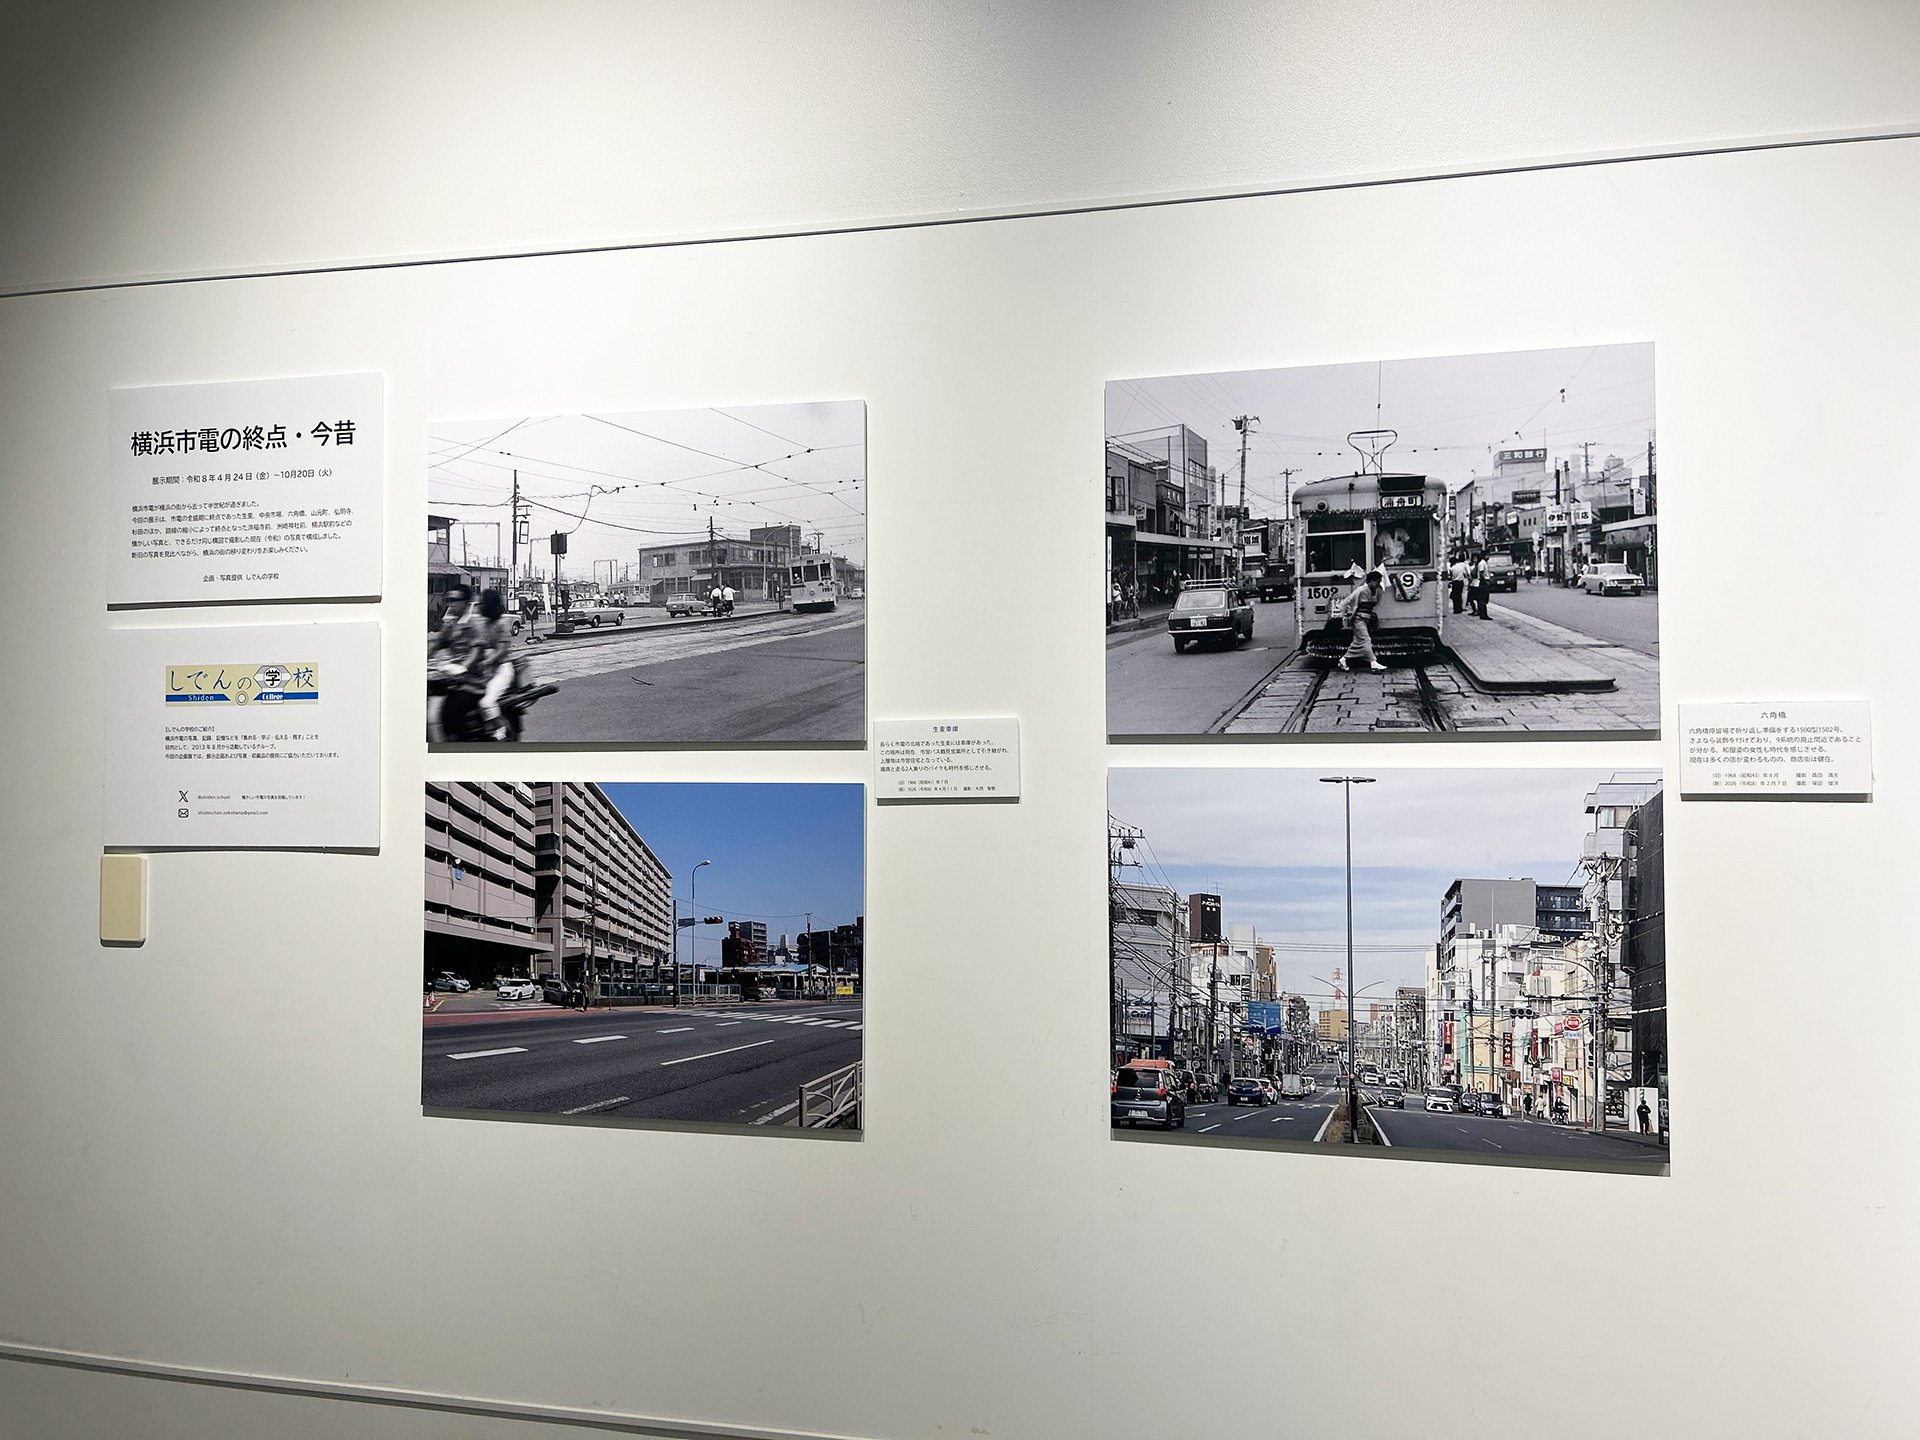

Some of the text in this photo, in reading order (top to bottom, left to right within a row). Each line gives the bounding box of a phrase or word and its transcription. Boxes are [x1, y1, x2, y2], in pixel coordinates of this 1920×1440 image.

[131, 419, 356, 457] 横浜市電の終点・今昔
[1403, 574, 1414, 588] 9
[262, 693, 284, 701] College
[1760, 711, 1787, 719] 六角橋
